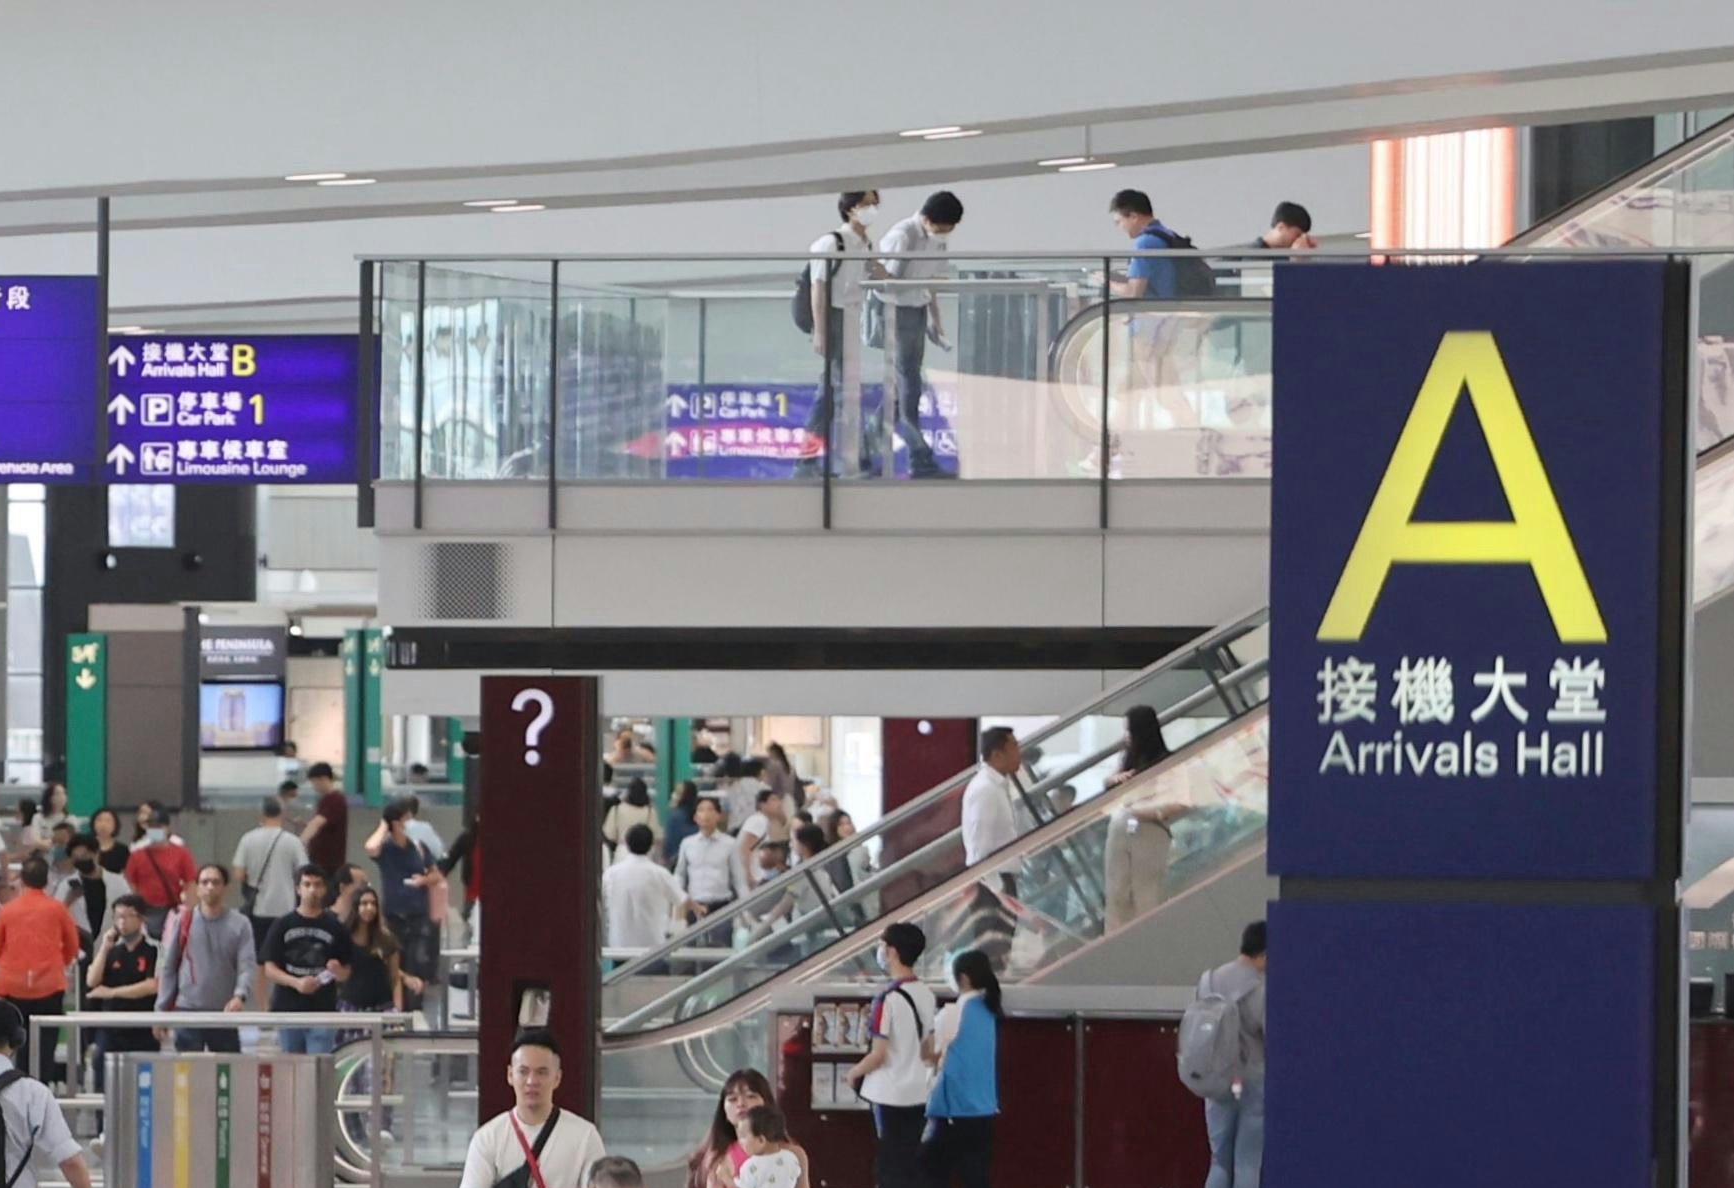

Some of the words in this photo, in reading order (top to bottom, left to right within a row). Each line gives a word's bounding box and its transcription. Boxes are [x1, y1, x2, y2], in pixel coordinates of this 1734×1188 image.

[143, 343, 229, 364] 接機大堂
[232, 345, 255, 376] B
[142, 362, 196, 377] Arrivals
[195, 362, 226, 377] Hall
[178, 392, 242, 412] 停車場
[249, 394, 263, 424] 1
[177, 410, 204, 426] Car
[204, 410, 237, 425] Park
[177, 440, 287, 460] 專車候車室
[40, 463, 73, 474] Area
[177, 459, 250, 475] Limousine
[253, 459, 307, 478] Lounge
[1317, 332, 1607, 642] A
[1317, 656, 1606, 723] 接機大堂
[1320, 731, 1498, 776] Arrivals
[1518, 731, 1603, 776] Hall
